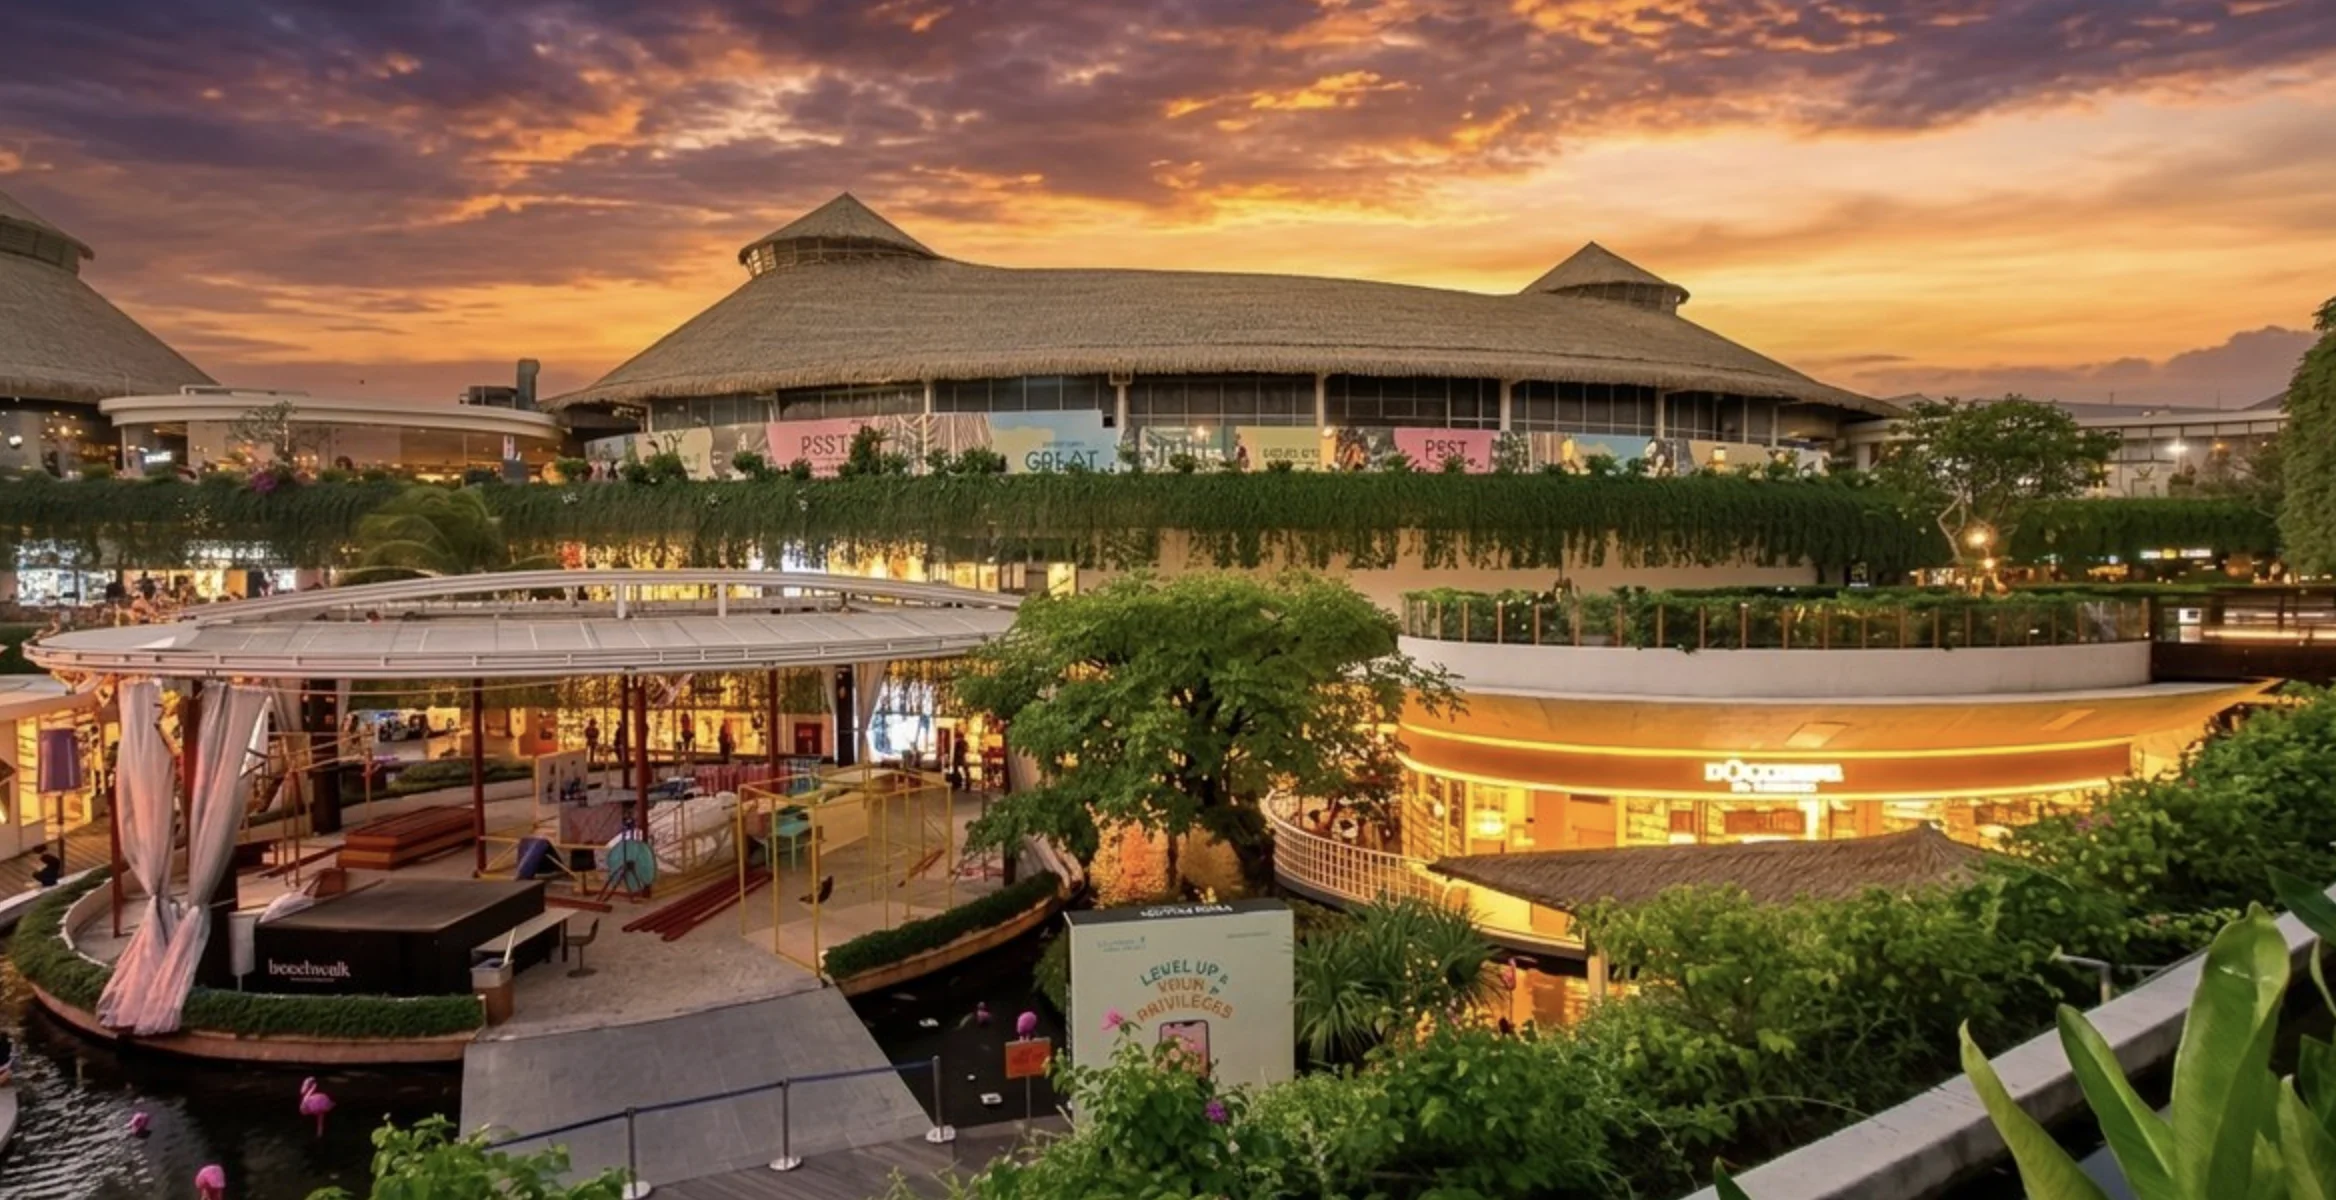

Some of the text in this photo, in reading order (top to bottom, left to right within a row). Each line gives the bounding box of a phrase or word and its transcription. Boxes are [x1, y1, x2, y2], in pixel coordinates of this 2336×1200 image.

[801, 434, 847, 455] PSST
[1025, 450, 1098, 471] GREAT
[1140, 959, 1219, 986] LEVEL UP
[1136, 994, 1233, 1023] PRIVILEGES
